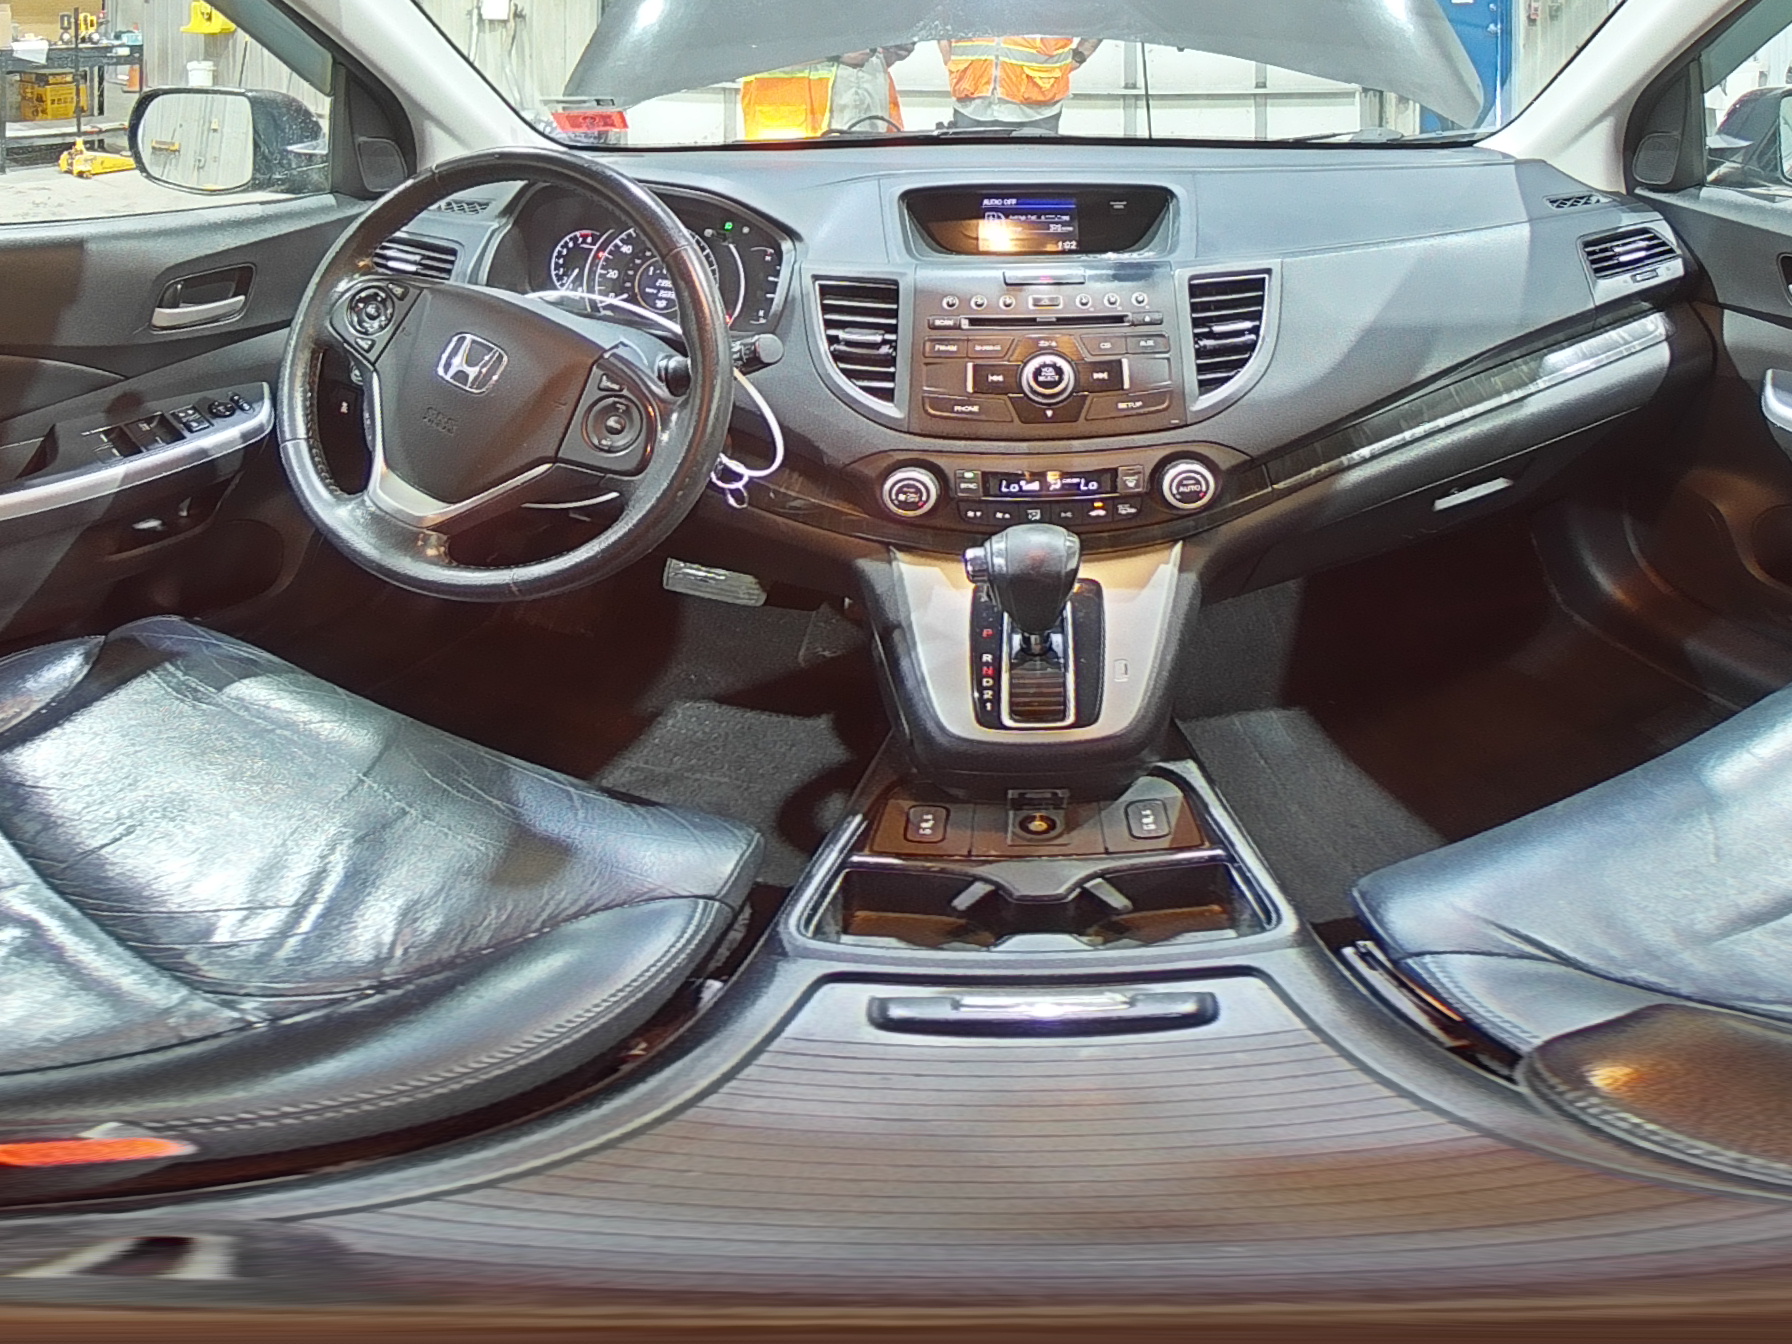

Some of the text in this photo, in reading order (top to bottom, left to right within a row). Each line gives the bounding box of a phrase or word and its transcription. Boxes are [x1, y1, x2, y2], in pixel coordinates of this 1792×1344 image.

[620, 244, 633, 254] 40
[606, 268, 619, 279] 20
[1178, 484, 1201, 493] AUTO
[982, 628, 993, 638] P
[981, 653, 993, 663] R
[982, 666, 994, 676] N
[982, 677, 994, 687] D
[982, 690, 994, 699] 2
[985, 702, 992, 711] 1
